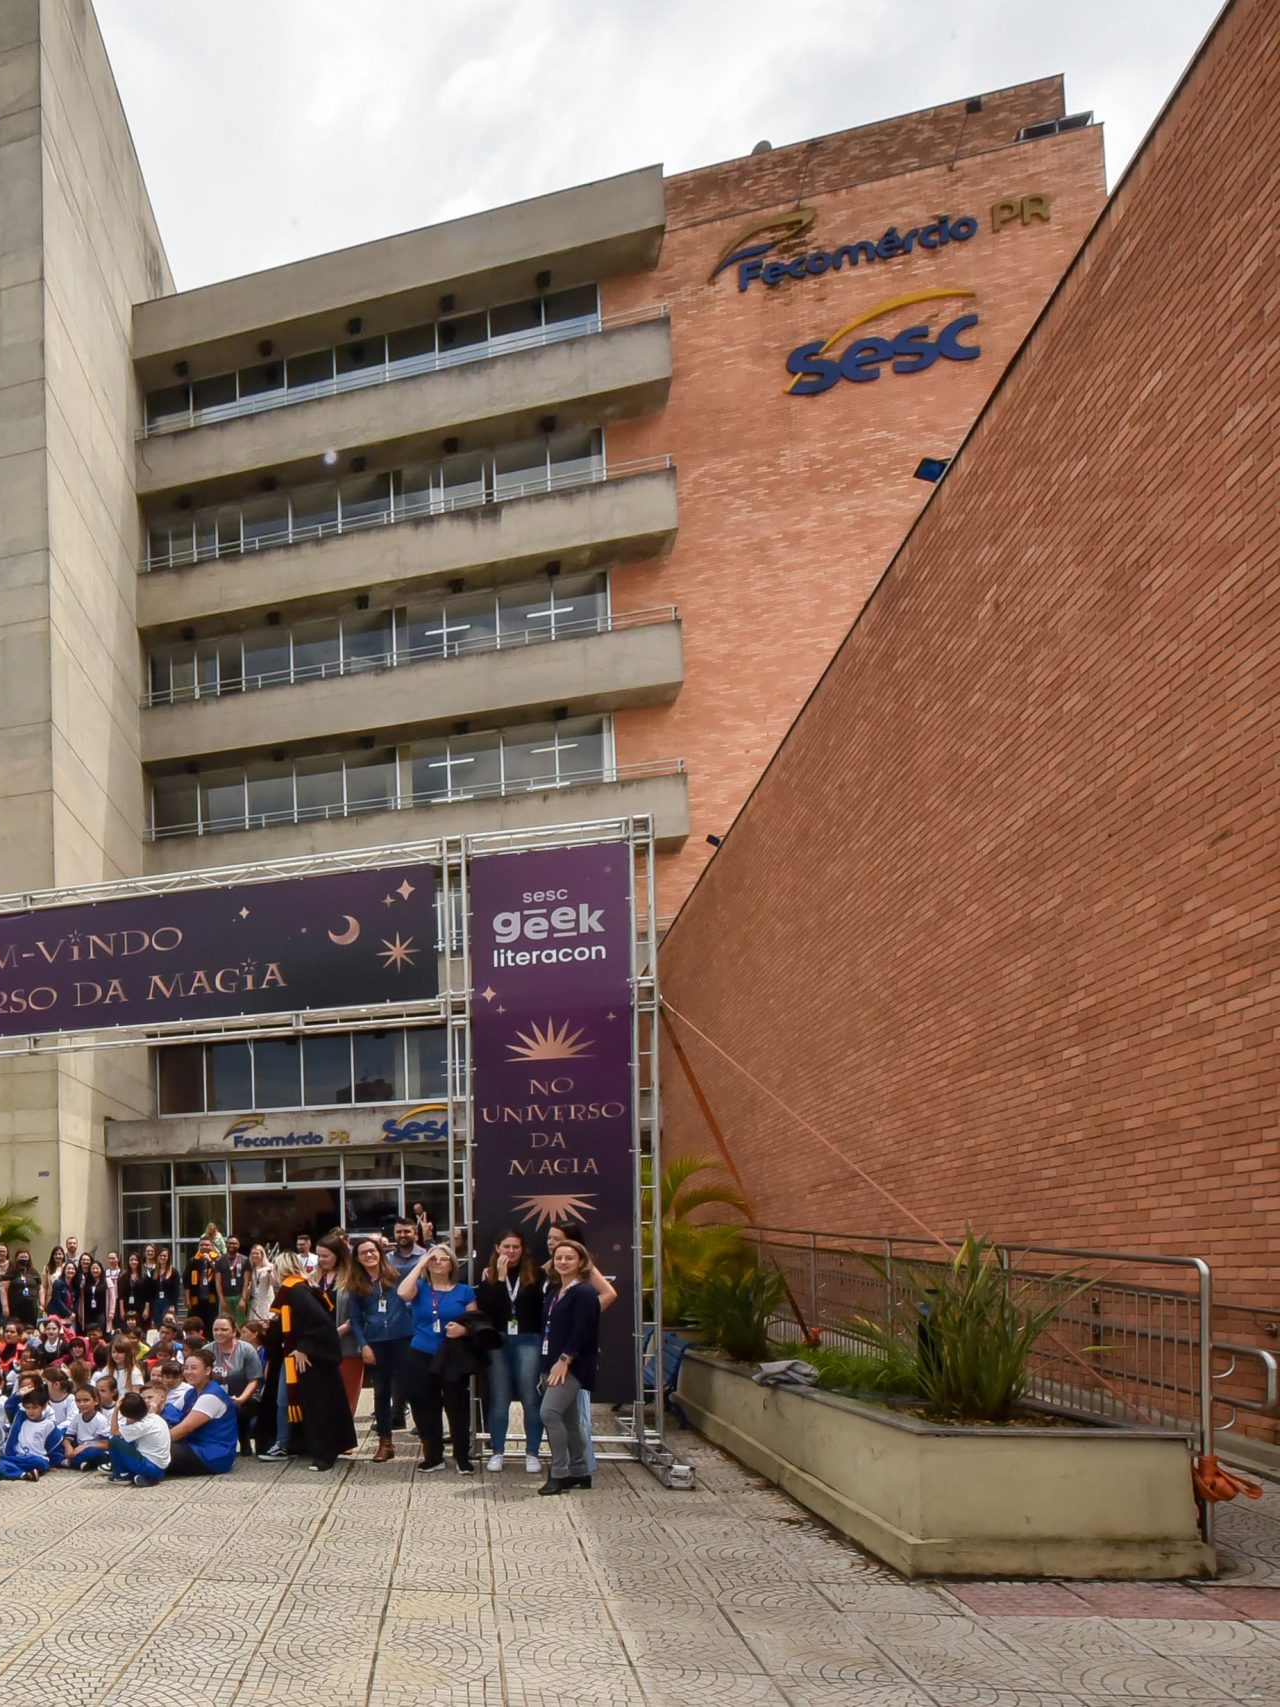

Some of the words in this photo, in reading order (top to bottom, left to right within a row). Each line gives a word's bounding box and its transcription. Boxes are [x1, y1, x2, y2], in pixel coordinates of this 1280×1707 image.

[738, 214, 979, 292] Fecomércio
[990, 191, 1053, 233] PR
[783, 313, 982, 395] Sesc
[522, 888, 568, 904] sesc
[493, 903, 606, 944] geek
[493, 945, 607, 968] literacon
[73, 979, 129, 1008] DA
[528, 1077, 574, 1096] NO
[481, 1102, 625, 1124] UNIVERSO
[530, 1132, 567, 1149] DA
[508, 1158, 600, 1176] MAGIA
